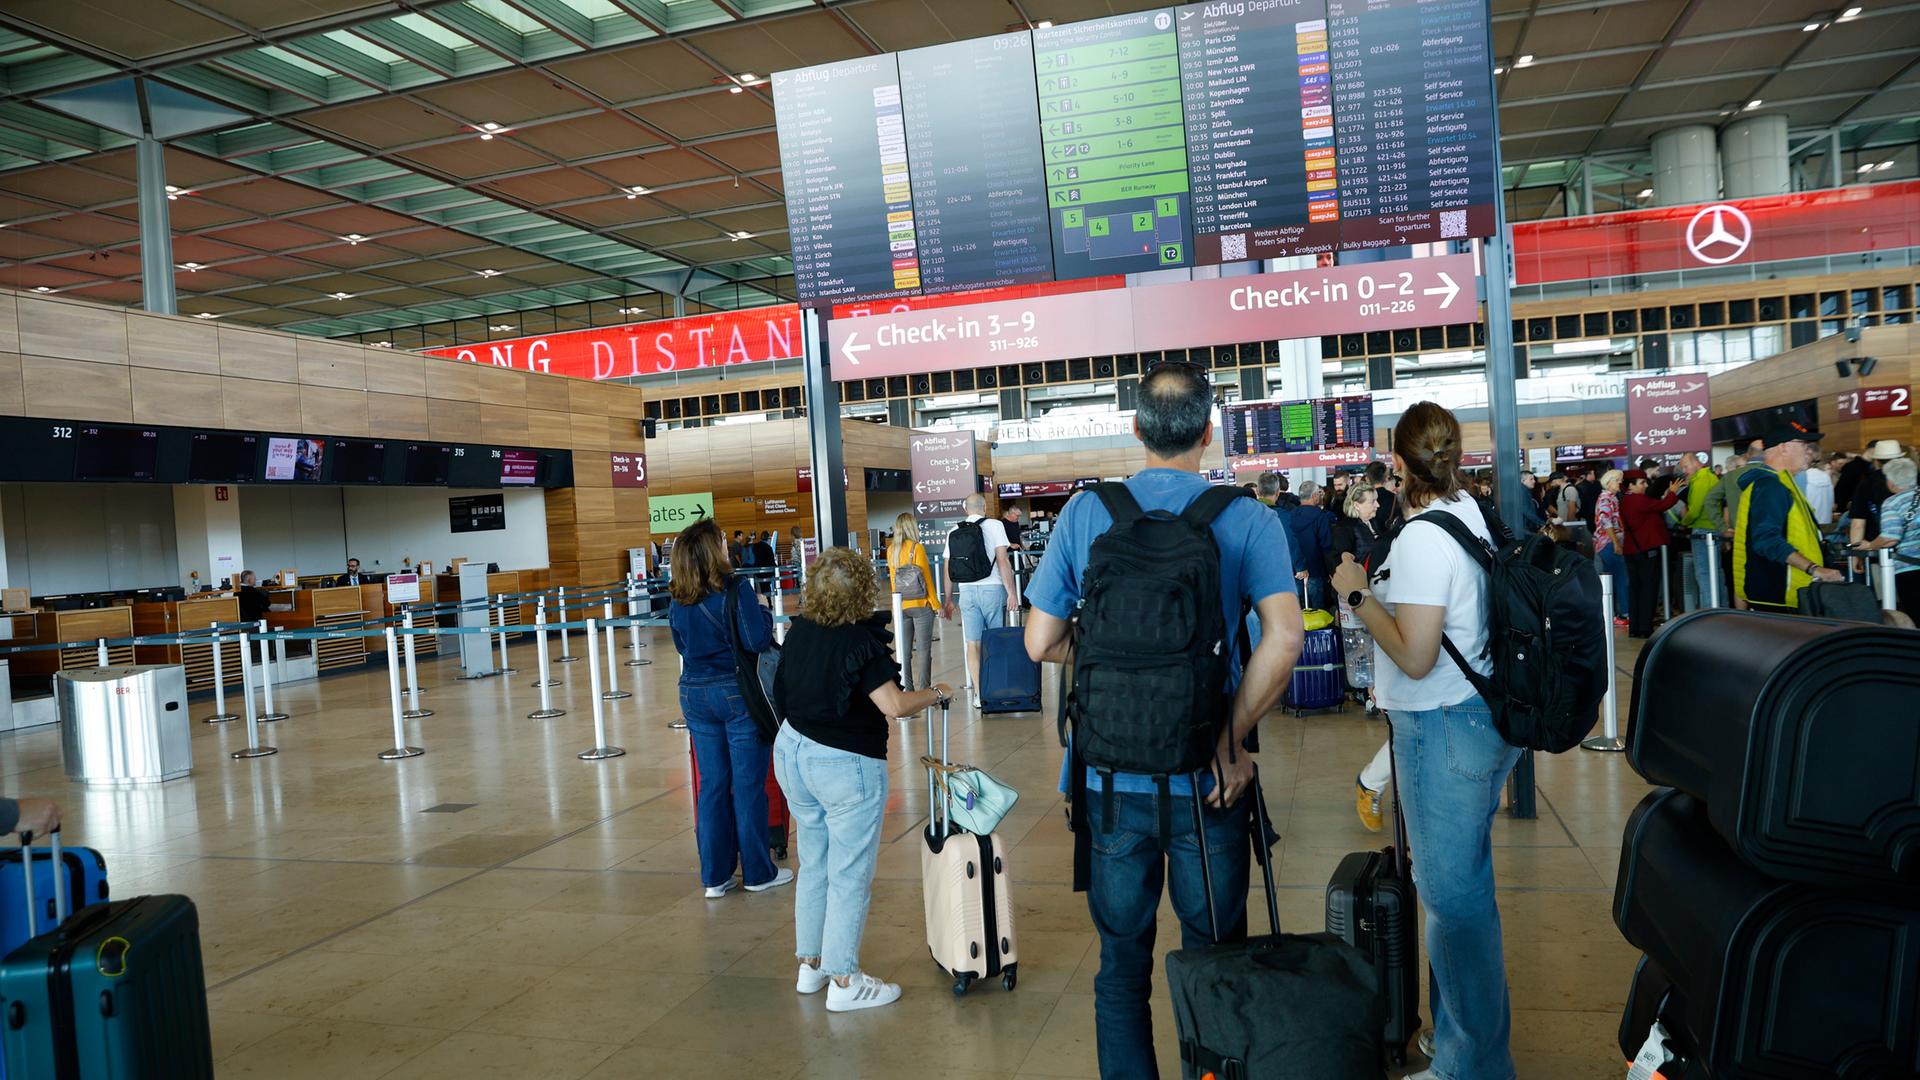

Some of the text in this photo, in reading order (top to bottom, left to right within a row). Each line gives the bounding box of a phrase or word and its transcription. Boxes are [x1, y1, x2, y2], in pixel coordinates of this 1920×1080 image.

[1203, 0, 1301, 18] Abflug Departure
[1036, 29, 1072, 40] Wartezeit
[1074, 16, 1148, 33] Sicherheitskontrolle
[994, 36, 1027, 50] 09:26
[1205, 34, 1236, 45] Paris CDG
[1370, 35, 1463, 54] 021-026 Abfertigung
[1109, 47, 1129, 57] 7-12
[1206, 46, 1236, 55] München
[794, 63, 879, 83] Abflug Departure
[1223, 66, 1238, 74] York
[1240, 64, 1255, 72] EWR
[1112, 71, 1128, 80] 4-9
[1208, 76, 1234, 87] Mailand
[1439, 79, 1462, 88] Service
[1209, 86, 1250, 98] Kopenhagen
[1440, 91, 1463, 99] Service
[1114, 93, 1134, 103] 5-10
[1210, 97, 1244, 108] Zakynthos
[1211, 110, 1226, 119] Split
[1374, 109, 1403, 118] 611-616
[1440, 112, 1464, 121] Service
[1116, 116, 1132, 126] 3-8
[1212, 120, 1232, 128] Zürich
[1375, 120, 1467, 133] 811-816 Abfertigung
[1230, 128, 1254, 137] Canaria
[1376, 130, 1404, 139] 924-926
[1118, 140, 1133, 148] 1-6
[1214, 139, 1251, 148] Amsterdam
[1376, 141, 1405, 150] 611-616
[1442, 145, 1466, 153] Service
[1214, 151, 1235, 159] Dublin
[1377, 152, 1468, 166] 421-426 Abfertigung
[805, 165, 837, 174] Amsterdam
[1215, 160, 1247, 170] Hurghada
[1378, 162, 1467, 177] 911-916 Self Service
[1216, 170, 1246, 180] Frankfurt
[1378, 173, 1469, 187] 421-426 Abfertigung
[1217, 178, 1267, 190] Istanbul Airport
[988, 189, 1023, 198] Abfertigung
[1218, 192, 1248, 200] München
[1379, 184, 1468, 198] 221-223 Self Service
[1218, 200, 1257, 210] London LHR
[1379, 195, 1408, 203] 611-616
[1444, 198, 1468, 206] Service
[1165, 202, 1169, 211] 1
[1380, 205, 1408, 214] 611-616
[811, 214, 831, 222] Belgrad
[1219, 212, 1248, 221] Teneriffa
[1407, 213, 1430, 222] further
[1071, 214, 1145, 231] 5 4 2
[1220, 222, 1251, 231] Barcelona
[1395, 223, 1431, 232] Departures
[1254, 226, 1304, 237] Weitere Abflüge
[952, 238, 1028, 252] 114-126 Abfertigung
[1255, 238, 1275, 246] finden
[1295, 239, 1390, 254] Großgepäck Bulky Baggage
[1166, 249, 1176, 257] T2
[818, 279, 844, 287] Frankfurt
[819, 288, 841, 296] Istanbul
[843, 296, 856, 304] jeder
[857, 291, 909, 301] Sicherheitskontrolle
[952, 281, 985, 291] Abfluggates
[986, 278, 1016, 286] erreichbar.
[1230, 272, 1414, 312] Check-in 0–2
[1360, 300, 1415, 316] 011–226
[877, 311, 1036, 347] Check-in 3–9
[989, 337, 1039, 351] 311–926
[591, 319, 793, 380] DISTAN
[1646, 380, 1676, 389] Abflug
[1647, 389, 1680, 397] Departure
[1891, 388, 1909, 411] 2
[1653, 404, 1692, 414] Check-in
[53, 427, 72, 438] 312
[1048, 423, 1134, 437] BRANDENB
[1649, 428, 1686, 437] Check-in
[455, 448, 464, 456] 315
[491, 450, 500, 458] 316
[930, 458, 959, 466] Check-in
[635, 457, 644, 480] 3
[649, 506, 685, 522] ates
[116, 687, 130, 695] BER
[1643, 1052, 1656, 1062] BER
